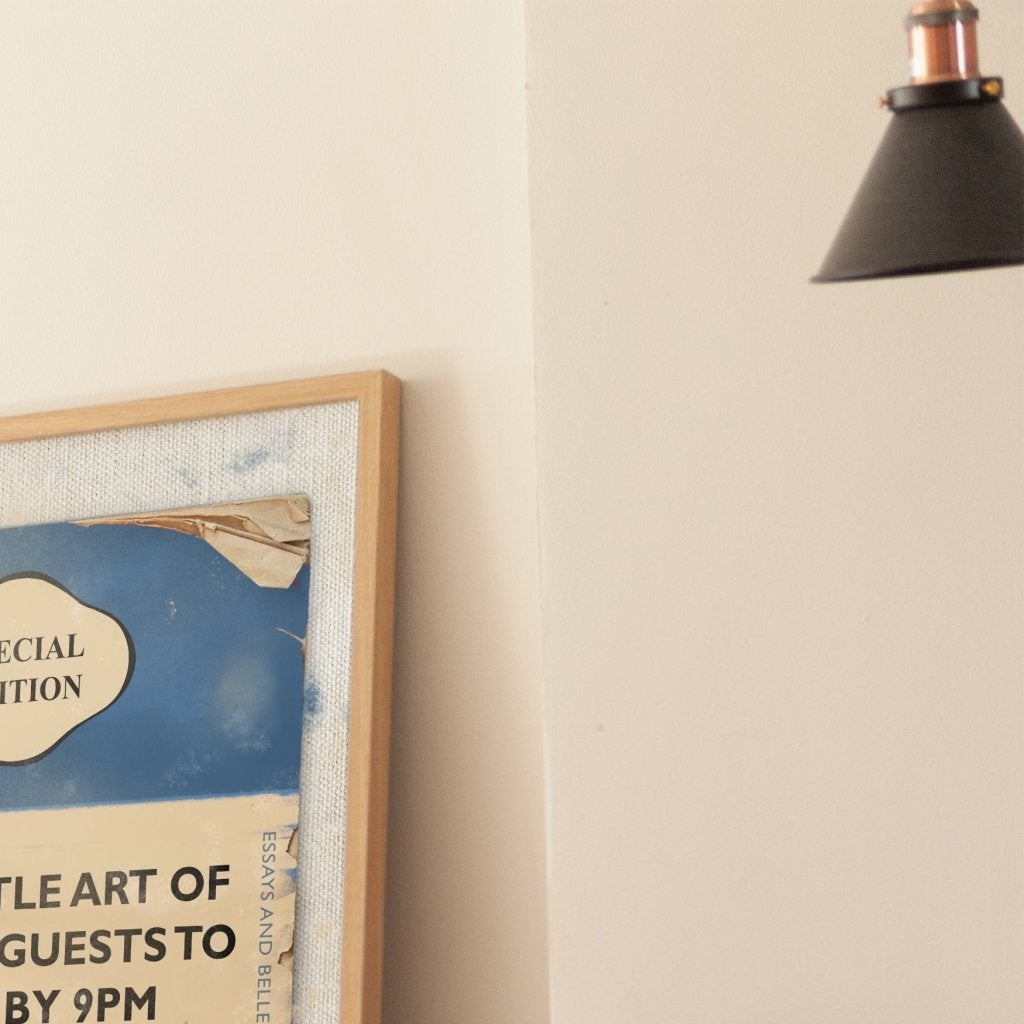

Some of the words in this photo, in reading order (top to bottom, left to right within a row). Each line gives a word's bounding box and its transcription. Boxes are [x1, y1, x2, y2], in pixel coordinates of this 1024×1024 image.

[70, 869, 157, 908] ART
[171, 865, 230, 902] OF
[260, 831, 277, 901] ESSAYS
[174, 924, 236, 960] TO
[258, 907, 274, 956] AND
[5, 990, 61, 1024] BY
[74, 986, 156, 1023] 9PM
